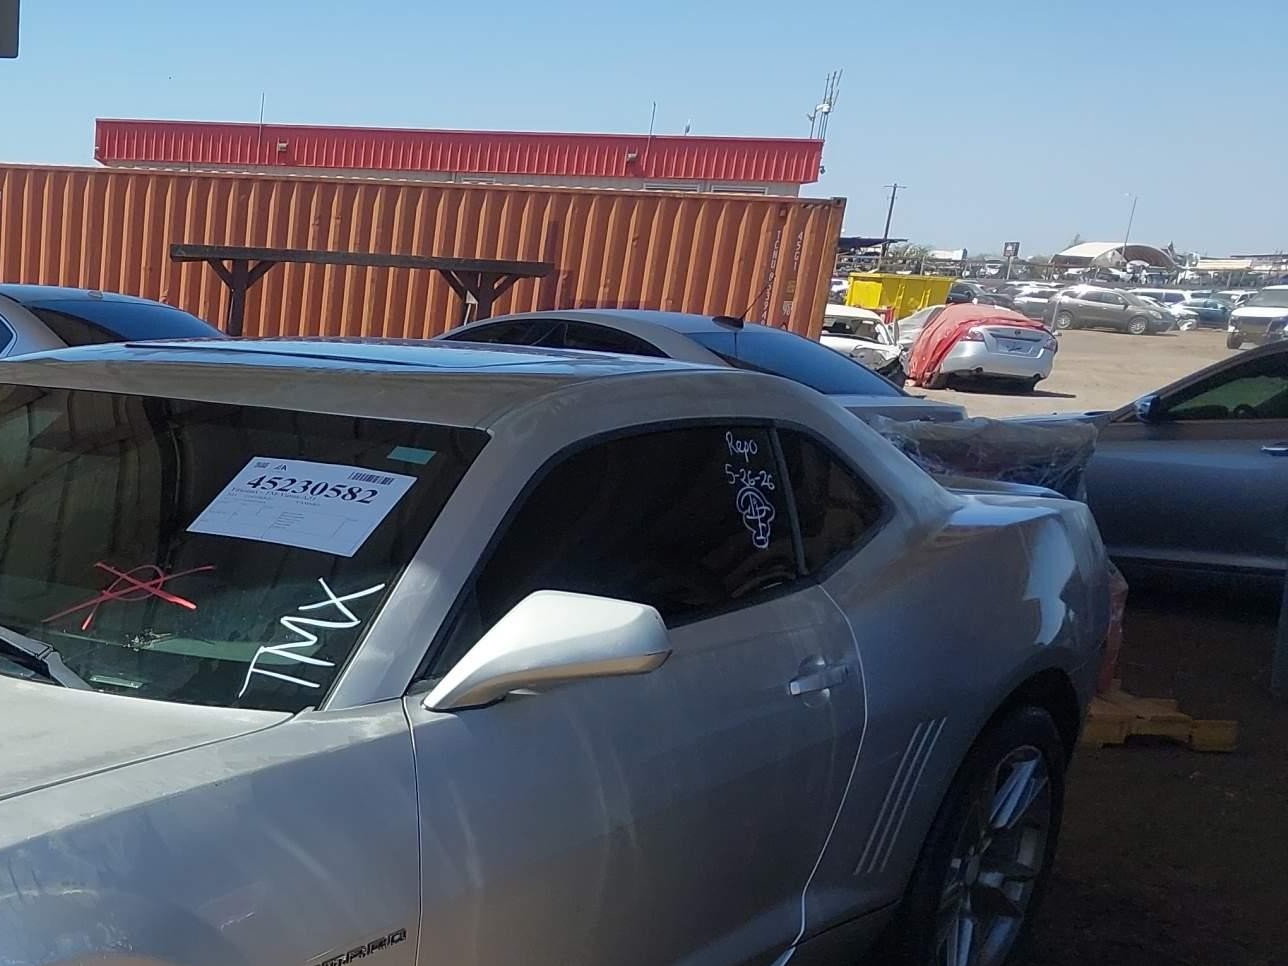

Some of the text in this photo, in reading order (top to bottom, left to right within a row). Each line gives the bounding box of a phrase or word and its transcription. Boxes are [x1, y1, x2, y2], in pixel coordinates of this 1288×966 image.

[725, 431, 758, 463] Repo
[247, 475, 379, 505] 45230582
[238, 576, 386, 699] TMX
